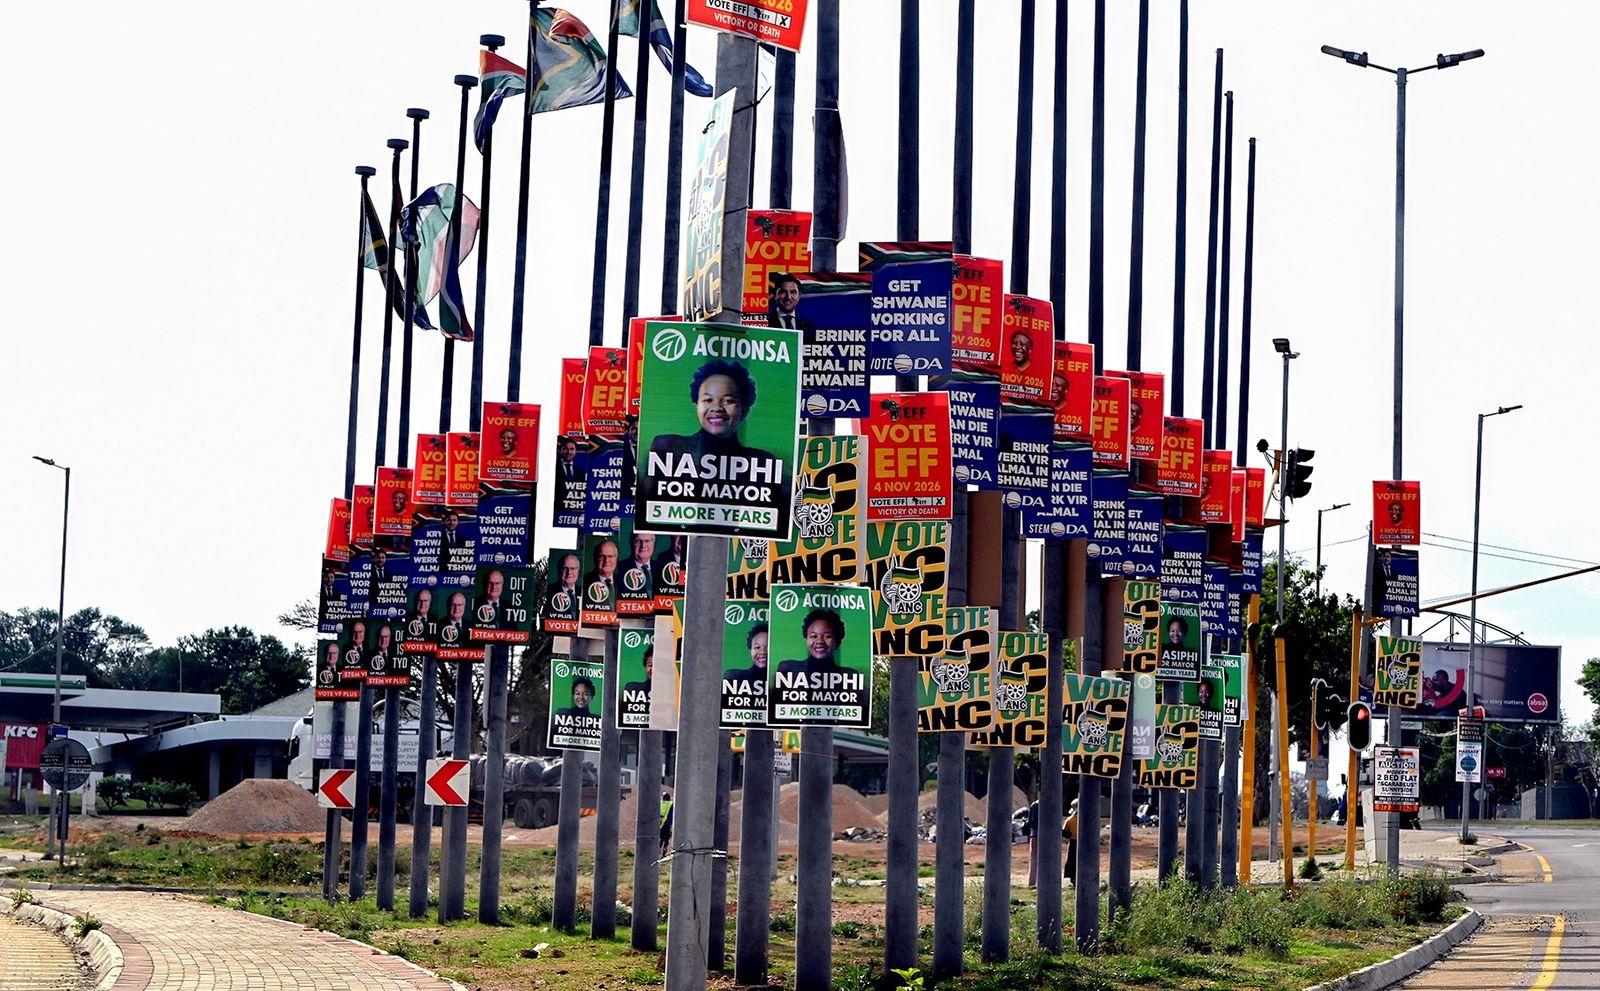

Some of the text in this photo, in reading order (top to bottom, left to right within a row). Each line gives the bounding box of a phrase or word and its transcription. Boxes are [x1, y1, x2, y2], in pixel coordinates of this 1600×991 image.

[733, 2, 746, 14] EFF
[714, 13, 780, 38] VICTORY OR DEATH
[776, 223, 800, 236] EFF
[746, 242, 808, 261] VOTE
[964, 270, 984, 280] EFF
[888, 280, 921, 292] GET
[1032, 319, 1050, 332] EFF
[816, 330, 866, 342] BRINK
[871, 330, 940, 341] FOR ALL
[968, 336, 991, 348] 2026
[692, 334, 790, 363] ACTIONSA
[838, 345, 866, 357] VIR
[849, 360, 865, 371] IN
[914, 358, 943, 370] DA
[1068, 361, 1088, 372] EFF
[1002, 373, 1044, 387] NOV 2026
[951, 390, 976, 402] KRY
[1142, 390, 1160, 400] EFF
[829, 399, 860, 412] DA
[904, 407, 926, 418] EFF
[487, 417, 536, 427] VOTE EFF
[1061, 415, 1082, 424] 2026
[968, 421, 988, 432] DIE
[871, 425, 937, 443] VOTE
[972, 435, 992, 448] VIR
[1099, 441, 1119, 450] 2026
[1136, 437, 1154, 445] 2026
[1013, 442, 1049, 453] BRINK
[875, 448, 938, 478] EFF
[1029, 454, 1049, 464] VIR
[1158, 450, 1194, 470] EFF
[648, 452, 782, 484] NASIPHI
[1036, 467, 1048, 476] IN
[1212, 464, 1228, 473] EFF
[971, 470, 992, 481] DA
[1179, 471, 1194, 479] 2026
[381, 479, 405, 490] VOTE
[596, 480, 621, 489] AAN
[874, 482, 940, 492] 4 NOV 2026
[1062, 484, 1082, 492] DIE
[658, 481, 771, 502] FOR MAYOR
[1022, 496, 1045, 507] DA
[1067, 495, 1087, 504] VIR
[1093, 501, 1125, 509] BRINK
[495, 506, 513, 514] GET
[652, 506, 771, 524] 5 MORE YEARS
[479, 516, 526, 525] TSHWANE
[558, 516, 578, 524] STEM
[590, 519, 609, 527] STEM
[1114, 521, 1125, 529] IN
[479, 526, 525, 535] WORKING
[808, 524, 834, 536] ANC
[1029, 524, 1088, 534] STEM DA
[482, 536, 521, 545] FOR ALL
[867, 522, 946, 560] VOTE
[1101, 546, 1122, 556] DA
[1132, 544, 1154, 553] ALL
[772, 547, 857, 584] ANC
[1105, 562, 1155, 573] VOTE DA
[510, 577, 527, 590] DIT
[512, 593, 521, 606] IS
[1181, 590, 1199, 598] DA
[1385, 594, 1417, 602] TSHWANE
[802, 592, 865, 610] ACTIONSA
[897, 602, 922, 612] ANC
[1167, 607, 1197, 618] ACTIONSA
[506, 609, 526, 622] TYD
[1210, 622, 1224, 631] DA
[1380, 636, 1421, 655] VOTE
[393, 658, 407, 668] TYD
[775, 672, 864, 690] NASIPHI
[947, 680, 970, 691] ANC
[1066, 674, 1129, 701] VOTE
[728, 696, 750, 706] FOR
[783, 691, 858, 703] FOR MAYOR
[1375, 692, 1416, 706] ANC
[628, 703, 645, 712] FOR
[1006, 700, 1027, 710] ANC
[735, 712, 763, 720] MORE
[780, 707, 858, 717] 5 MORE YEARS
[4, 726, 38, 738] KFC
[575, 728, 601, 736] MAYOR
[970, 720, 1045, 745] ANC
[1142, 769, 1195, 788] ANC
